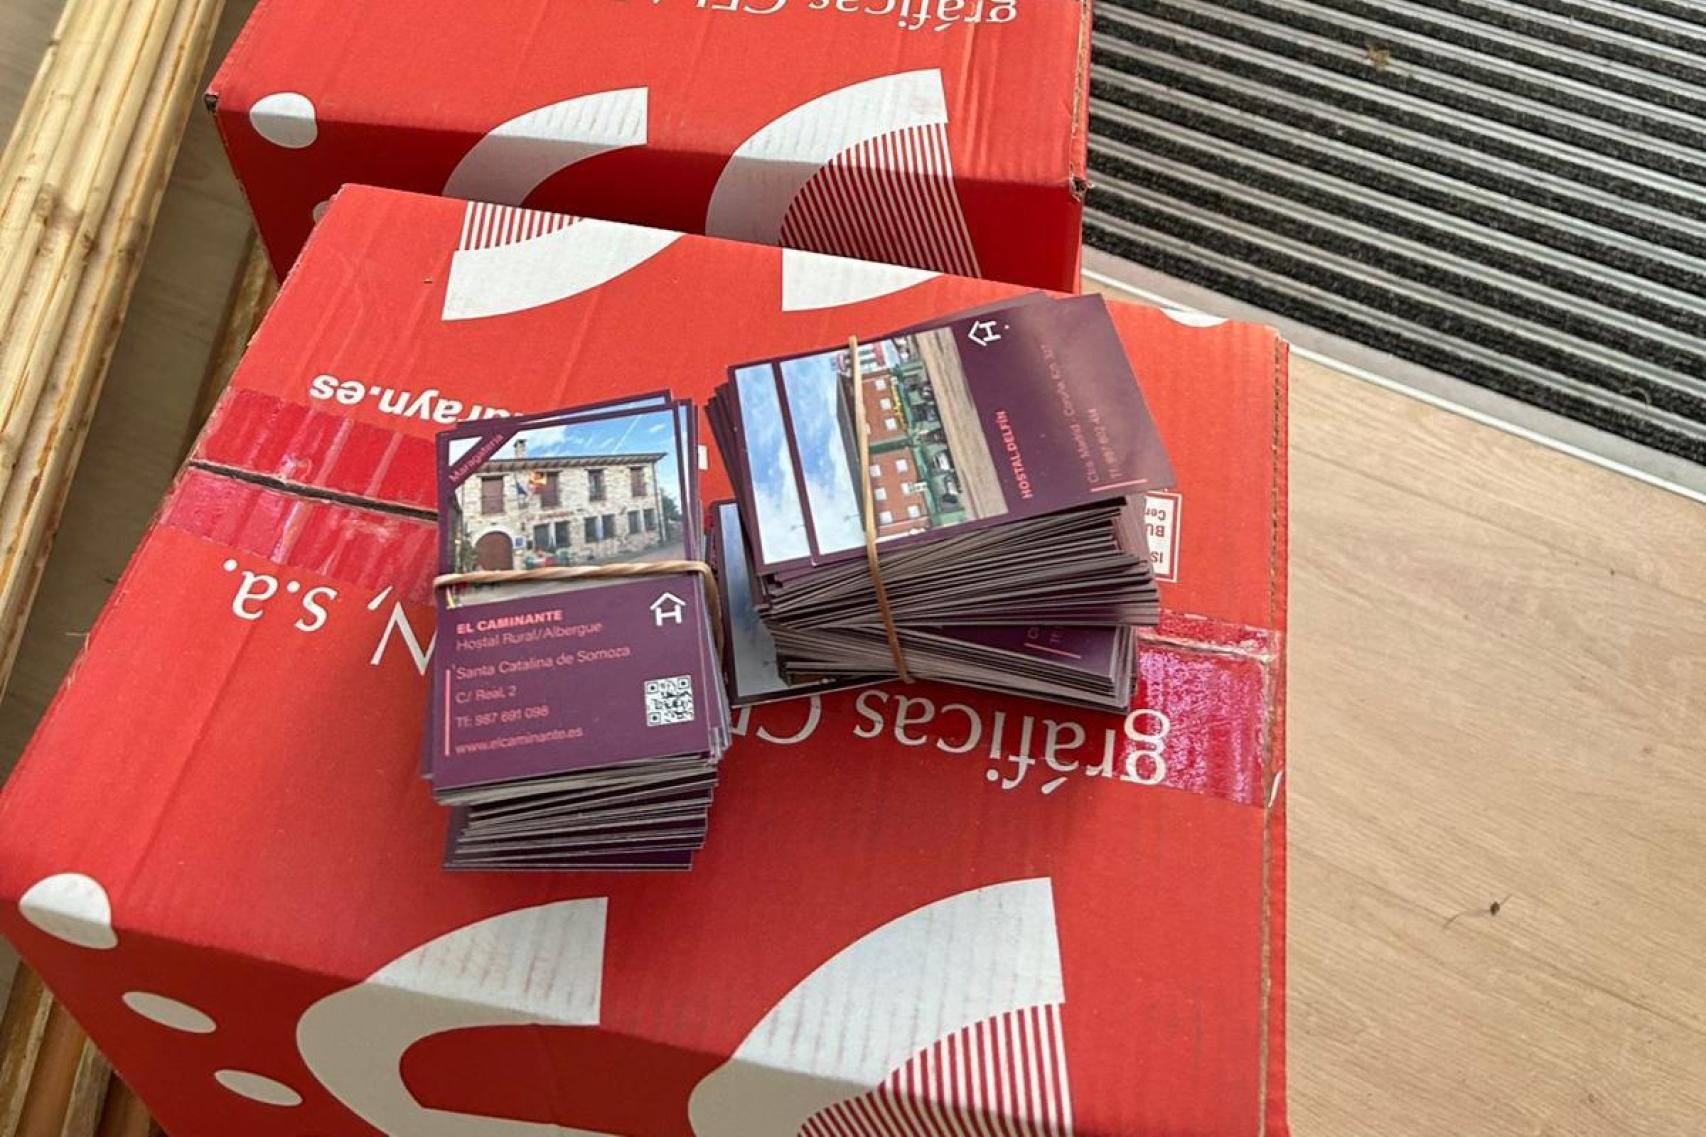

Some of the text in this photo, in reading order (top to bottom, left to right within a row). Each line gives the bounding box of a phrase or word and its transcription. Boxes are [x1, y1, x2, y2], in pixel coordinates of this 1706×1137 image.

[222, 558, 338, 632] s.a.
[456, 610, 564, 635] EL CAMINANTE
[456, 621, 604, 652] Hostal Rural/Albergue
[455, 645, 631, 681] Santa Catalina de Somoza
[508, 685, 518, 698] 2
[853, 688, 1171, 795] gráficas
